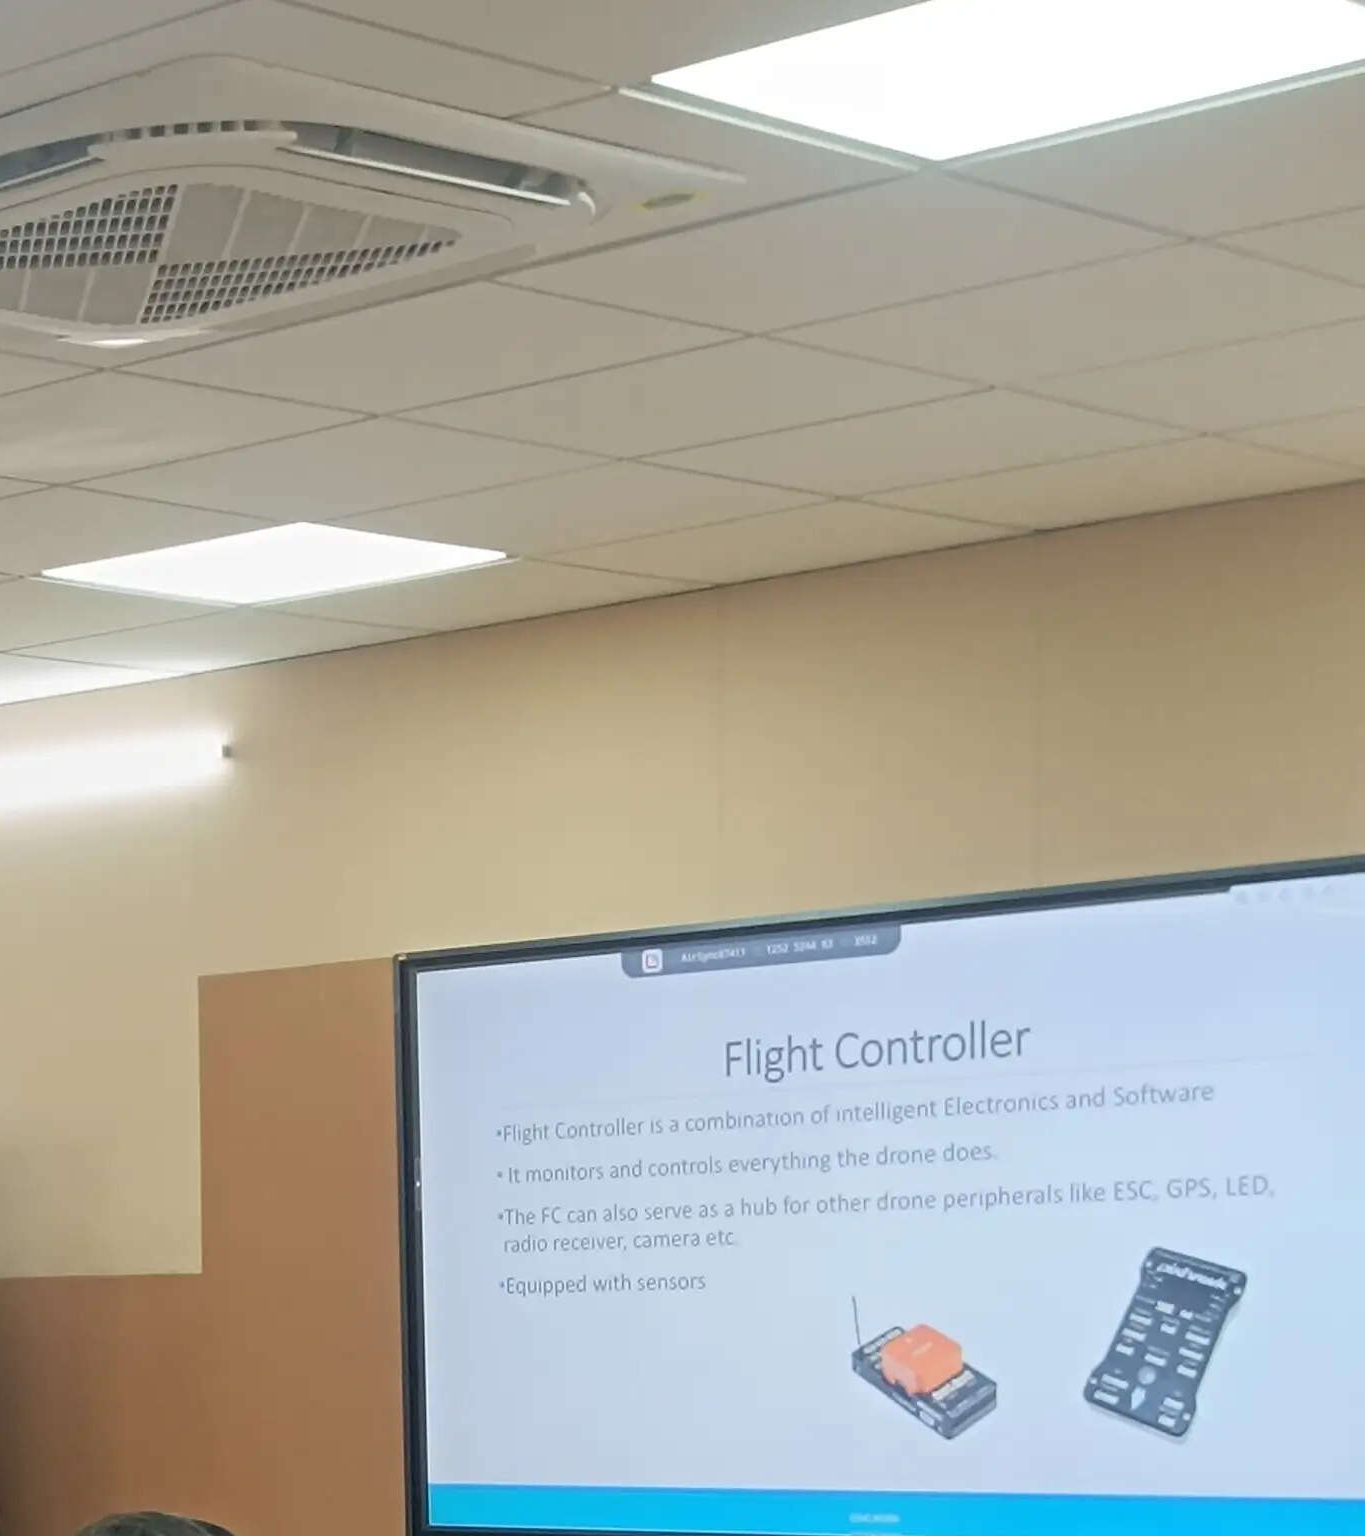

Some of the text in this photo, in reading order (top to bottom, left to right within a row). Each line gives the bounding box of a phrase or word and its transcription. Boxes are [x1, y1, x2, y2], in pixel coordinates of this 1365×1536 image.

[725, 1020, 1031, 1083] Flight Controller
[502, 1083, 1214, 1146] Flight Controller is a combination of intelligent Electronics and Software
[508, 1142, 997, 1184] It monitors and controls everything the drone does.
[504, 1207, 536, 1226] The
[541, 1206, 561, 1224] FC
[567, 1208, 597, 1223] can
[603, 1203, 638, 1222] also
[644, 1204, 692, 1220] serve
[698, 1203, 718, 1218] as
[724, 1203, 734, 1217] a
[741, 1195, 777, 1216] hub
[784, 1194, 810, 1215] for
[816, 1193, 869, 1214] other
[876, 1191, 936, 1212] drone
[943, 1184, 1063, 1211] peripherals
[1070, 1182, 1106, 1203] like
[1166, 1177, 1217, 1201] GPS,
[503, 1234, 548, 1254] radio
[553, 1233, 628, 1253] receiver,
[633, 1230, 700, 1248] camera
[506, 1273, 706, 1298] Equipped with sensors
